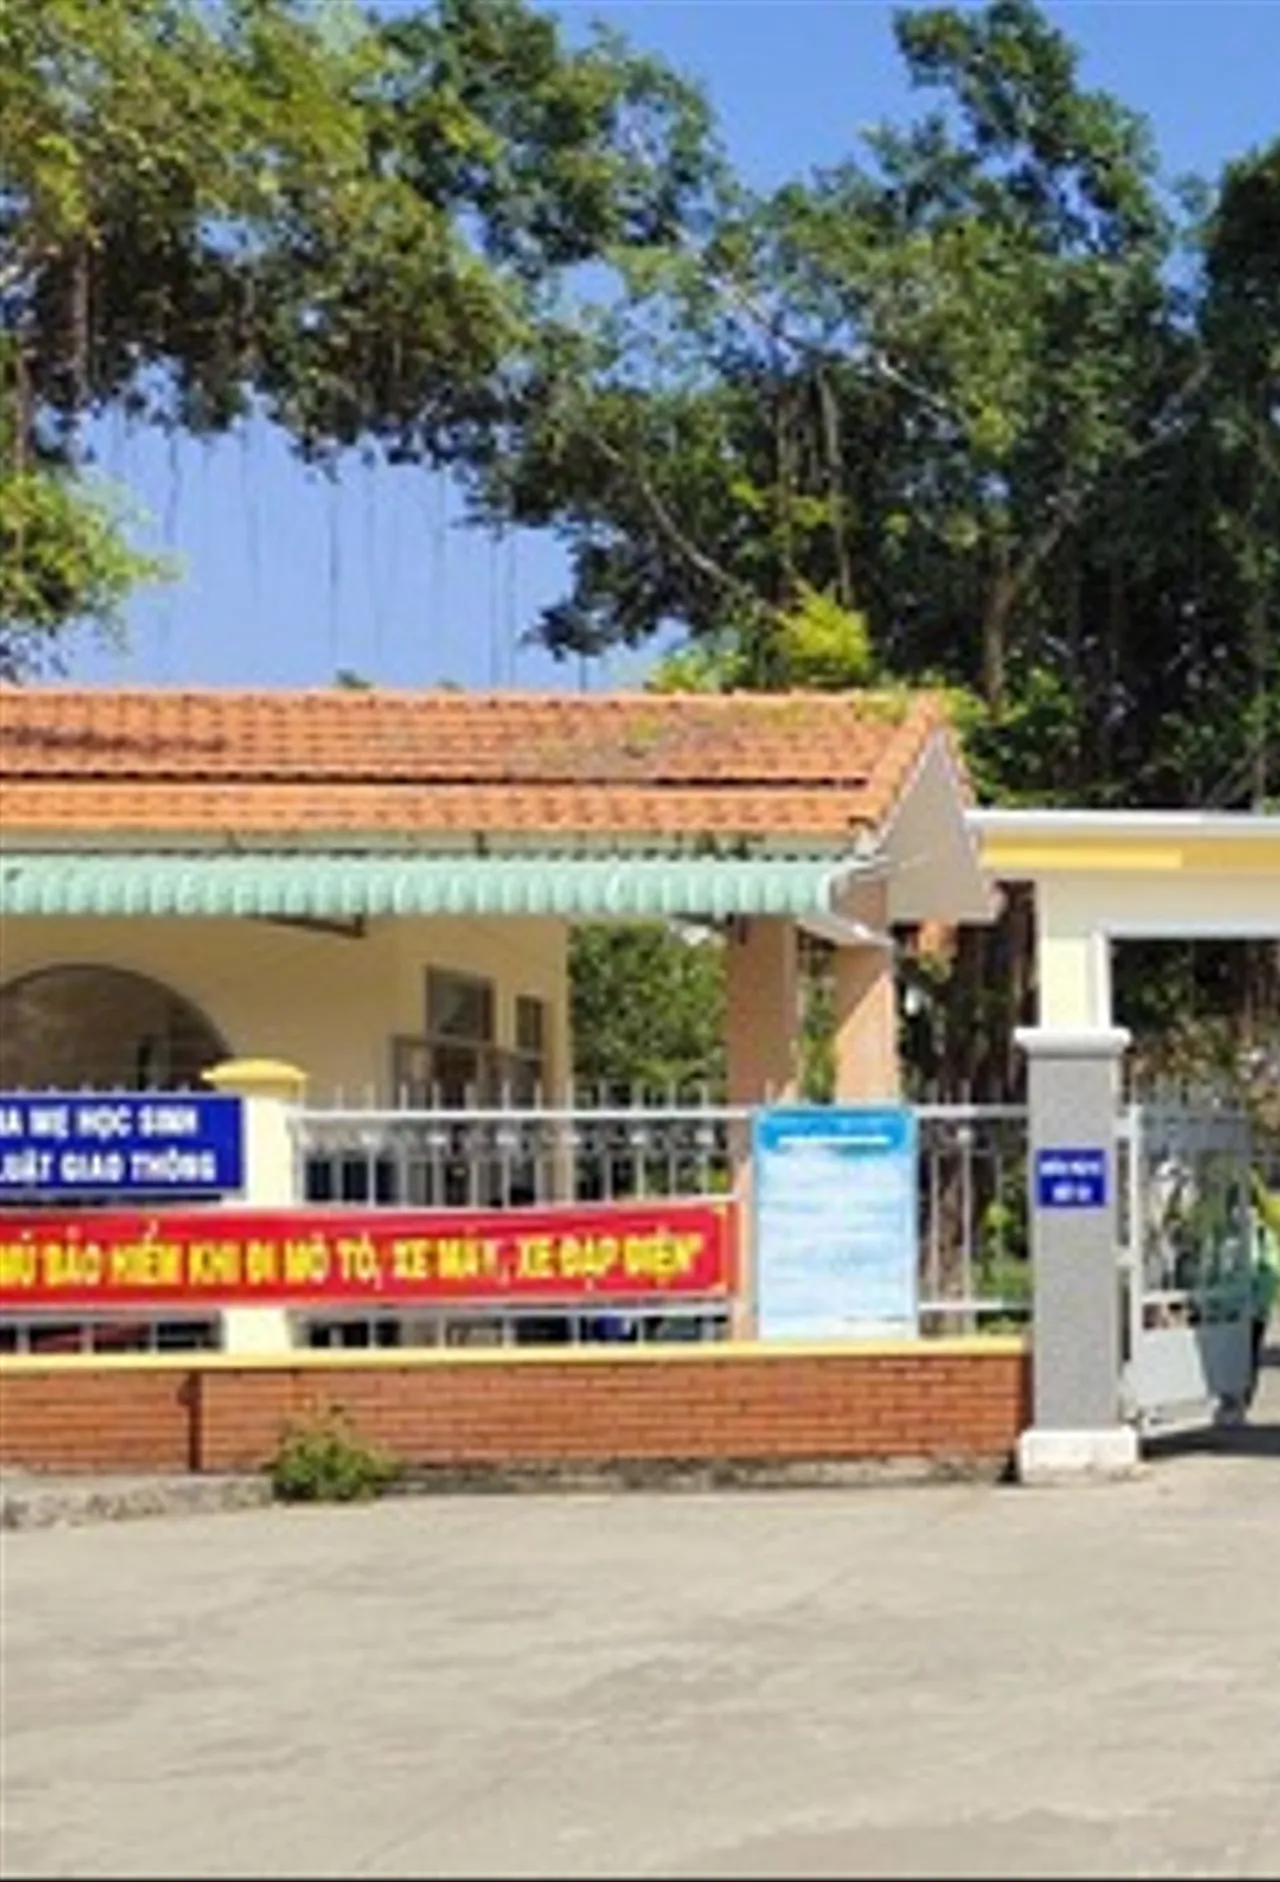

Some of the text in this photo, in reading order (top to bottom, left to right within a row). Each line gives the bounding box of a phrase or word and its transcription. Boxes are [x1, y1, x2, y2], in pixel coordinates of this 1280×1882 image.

[29, 1104, 71, 1142] MẸ
[77, 1103, 133, 1144] HỌC
[138, 1104, 198, 1138] SINH
[60, 1151, 125, 1184] GIAO
[130, 1145, 218, 1184] THÔNG
[43, 1225, 102, 1286] BẢO
[110, 1219, 183, 1286] HIỂM
[188, 1240, 242, 1286] KHI
[246, 1240, 278, 1285] ĐI
[284, 1231, 331, 1285] MÔ
[392, 1239, 430, 1280] XE
[515, 1235, 556, 1280] XE
[559, 1234, 620, 1291] ĐẠP
